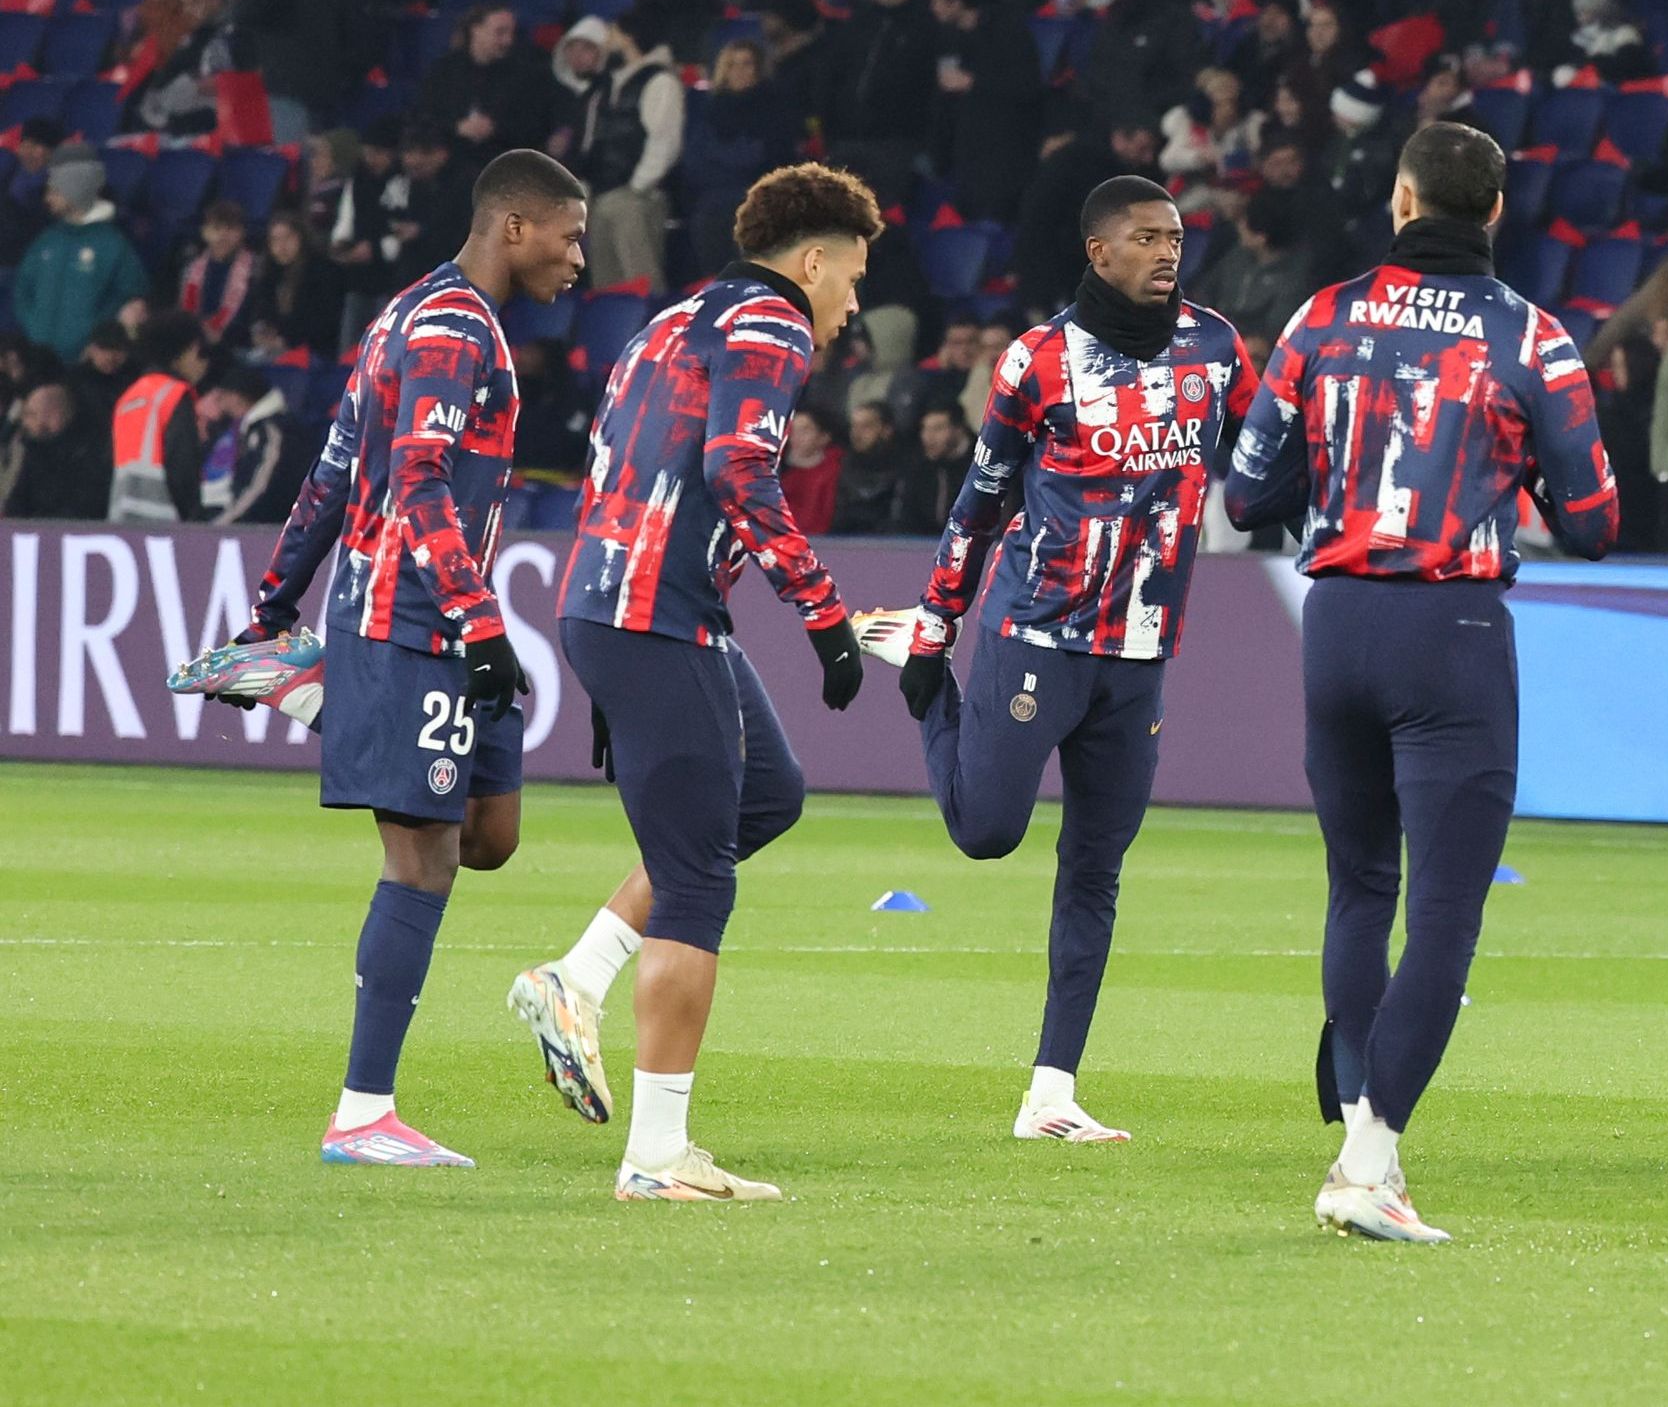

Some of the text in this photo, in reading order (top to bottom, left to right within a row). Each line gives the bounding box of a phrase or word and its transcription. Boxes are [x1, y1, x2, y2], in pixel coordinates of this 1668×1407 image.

[1386, 284, 1465, 310] VISIT
[1349, 301, 1484, 340] RWANDA
[1091, 418, 1201, 460] QATAR
[1122, 447, 1201, 472] AIRWAYS
[1023, 672, 1037, 692] 10
[417, 690, 475, 756] 25
